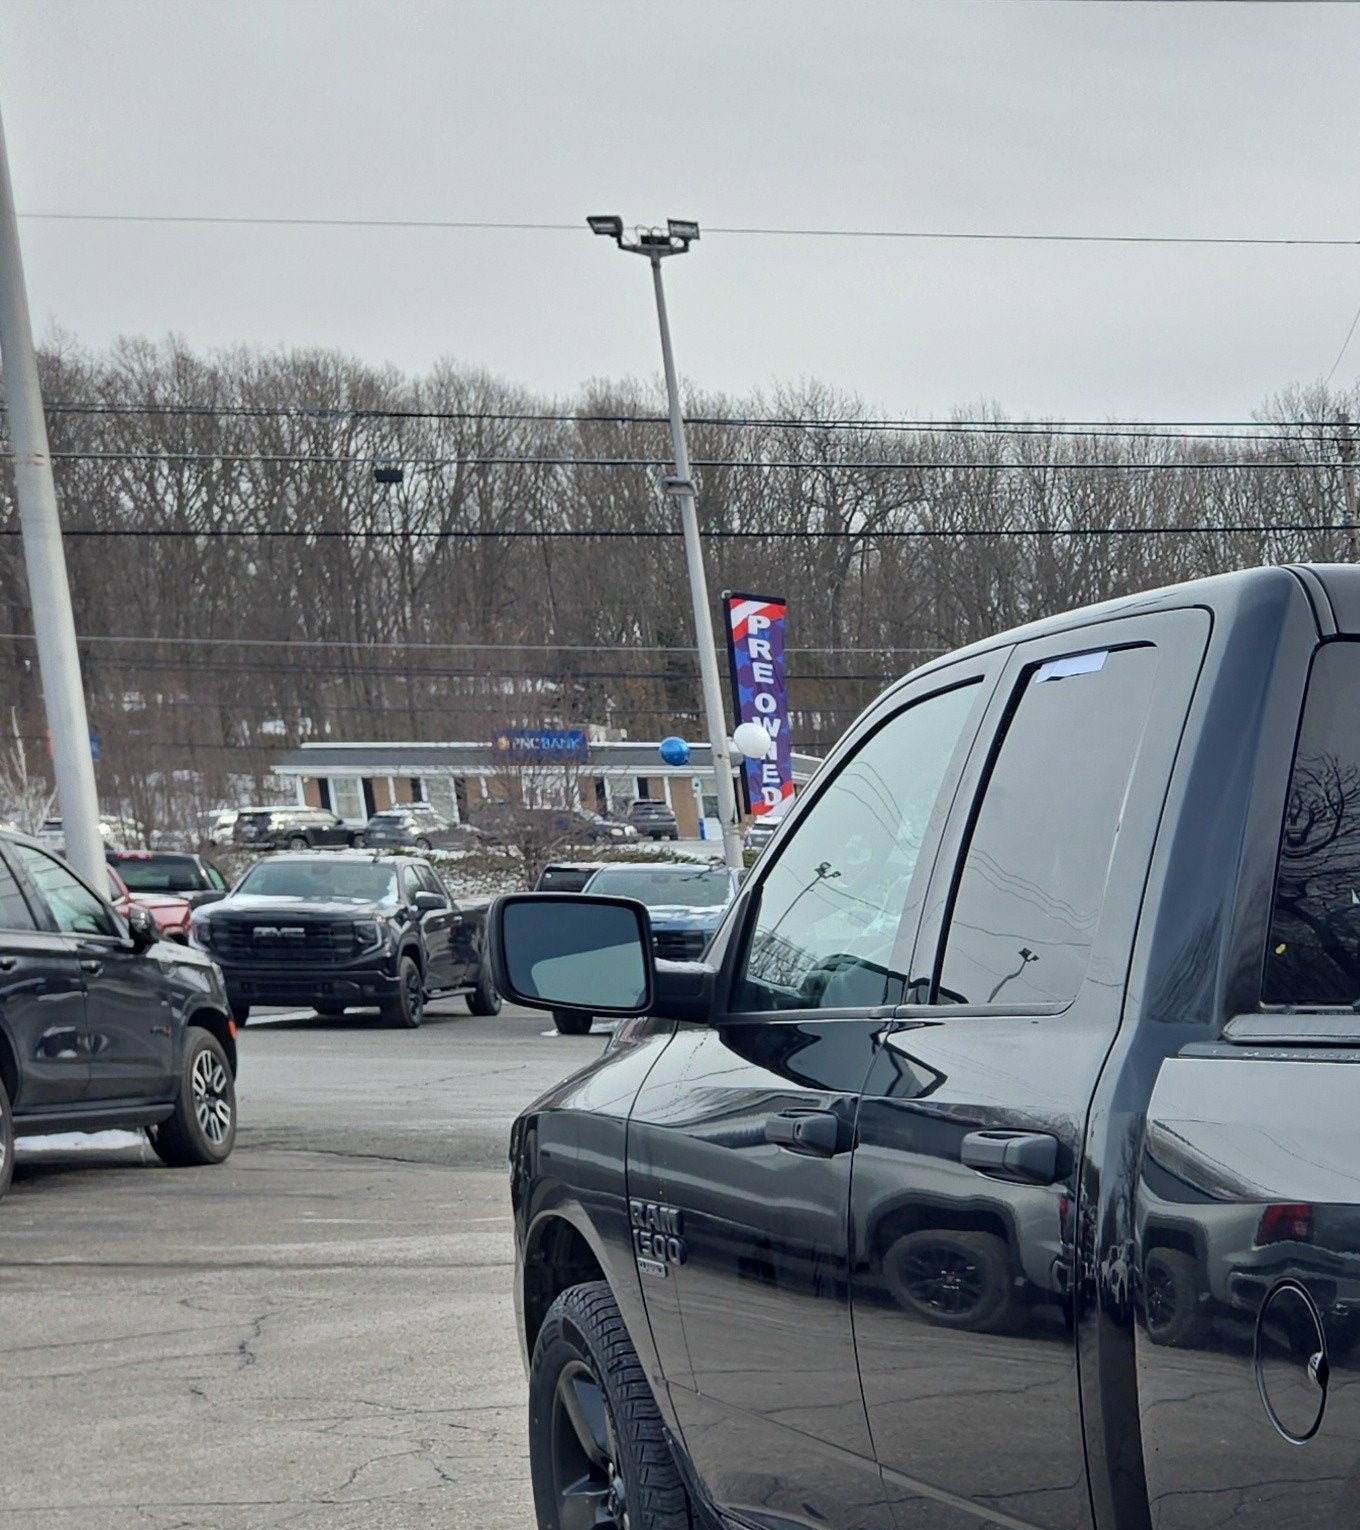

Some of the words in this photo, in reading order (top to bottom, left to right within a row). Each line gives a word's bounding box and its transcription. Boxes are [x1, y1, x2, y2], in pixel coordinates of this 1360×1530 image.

[748, 614, 773, 685] PRE
[630, 1200, 681, 1237] RAM
[632, 1228, 683, 1265] 1500
